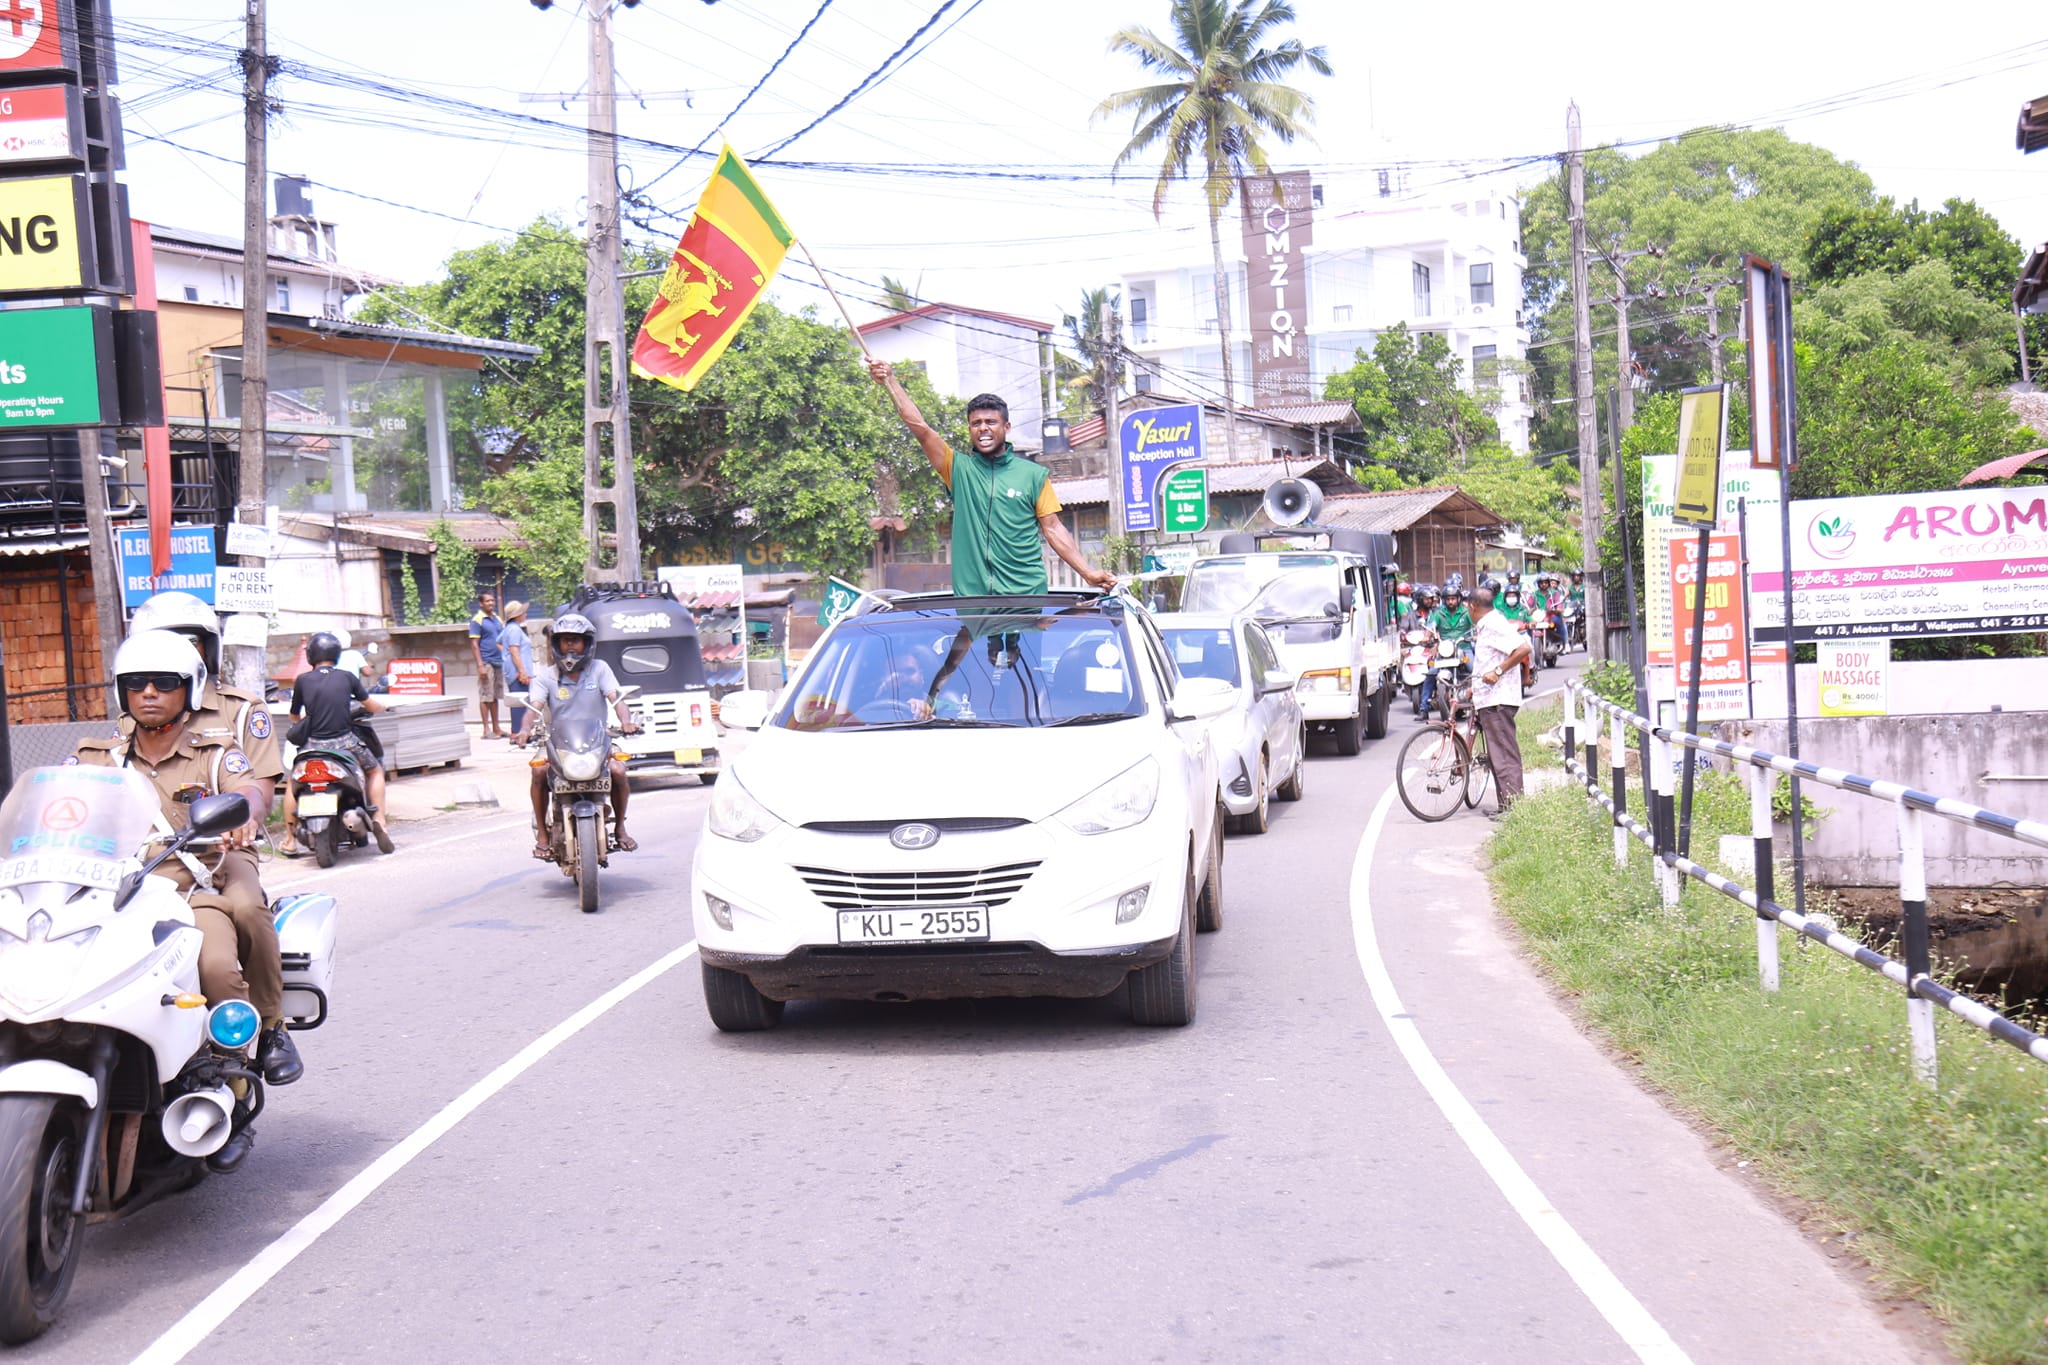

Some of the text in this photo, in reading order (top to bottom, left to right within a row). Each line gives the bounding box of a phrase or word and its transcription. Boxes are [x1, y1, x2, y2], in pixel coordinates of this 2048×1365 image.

[0, 396, 64, 408] perating Hours
[5, 407, 55, 417] 9am to 9pm
[380, 417, 407, 430] YEAR
[1133, 418, 1192, 452] Yasuri
[1129, 446, 1194, 462] Reception Hall
[171, 536, 210, 554] HOSTEL
[129, 574, 212, 591] RESTAURANT
[230, 572, 266, 582] HOUSE
[221, 583, 273, 594] FOR RENT
[1982, 584, 2010, 593] Herbal
[1983, 600, 2030, 611] Channeling
[1815, 628, 1832, 636] 441
[1852, 625, 1889, 635] Matara
[1892, 623, 1917, 633] Road
[1981, 618, 2000, 627] 041
[2011, 618, 2025, 626] 22
[2027, 616, 2040, 625] 61
[1836, 653, 1870, 667] BODY
[1823, 670, 1880, 685] MASSAGE
[1680, 688, 1743, 700] Opning Hours
[1728, 702, 1743, 710] am
[11, 832, 117, 855] POLICE
